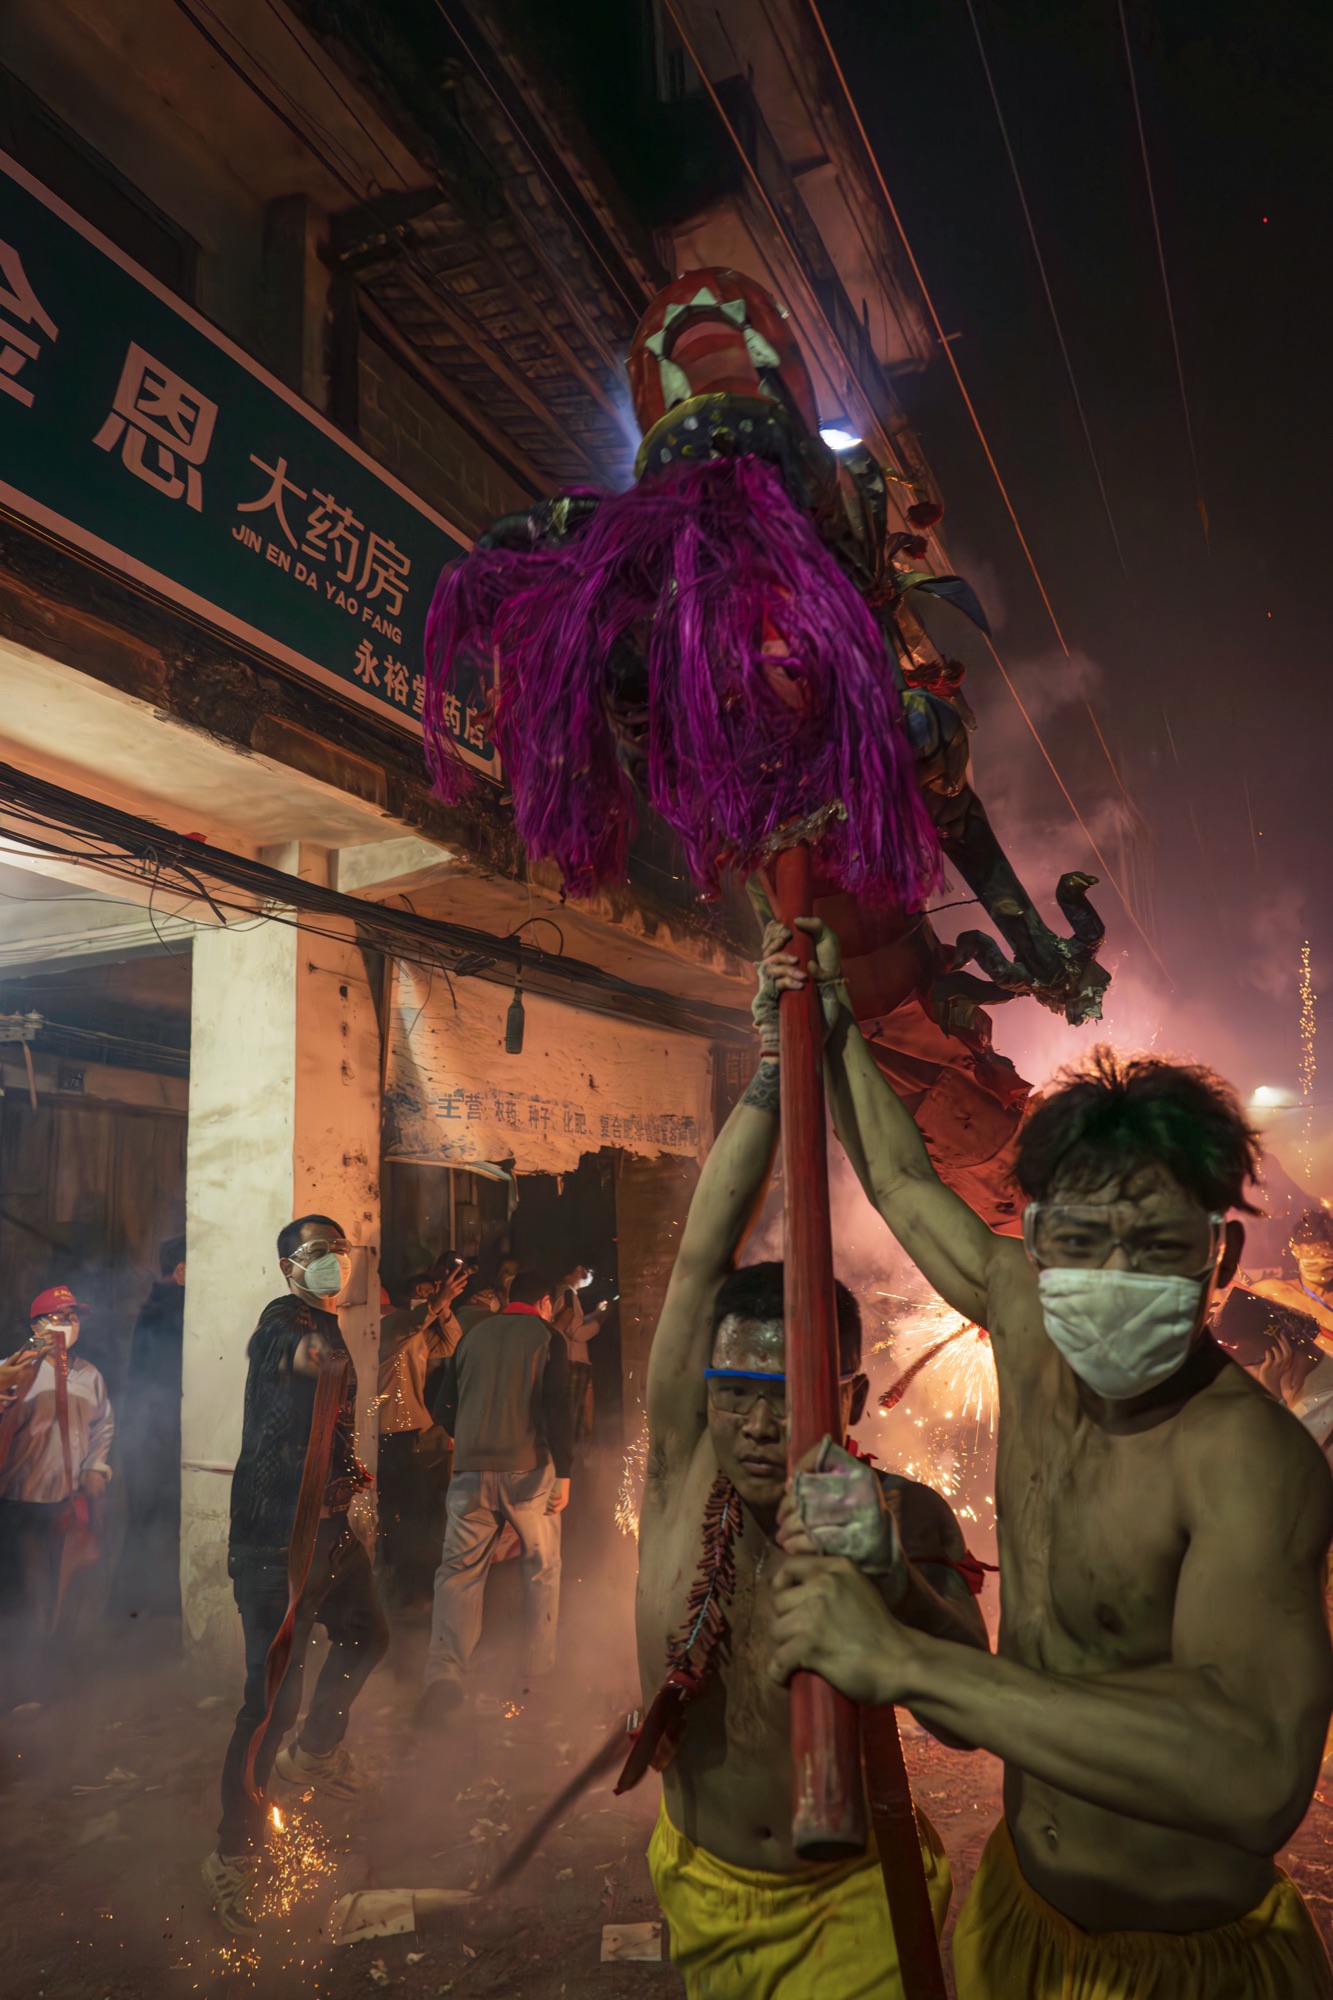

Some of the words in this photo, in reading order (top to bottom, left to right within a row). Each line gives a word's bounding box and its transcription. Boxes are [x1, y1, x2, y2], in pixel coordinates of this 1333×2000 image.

[231, 524, 263, 553] JIN
[265, 543, 292, 572] EN
[294, 562, 318, 591] DA
[325, 581, 359, 615] YAO
[361, 606, 403, 645] FANG
[237, 453, 411, 617] 大药房
